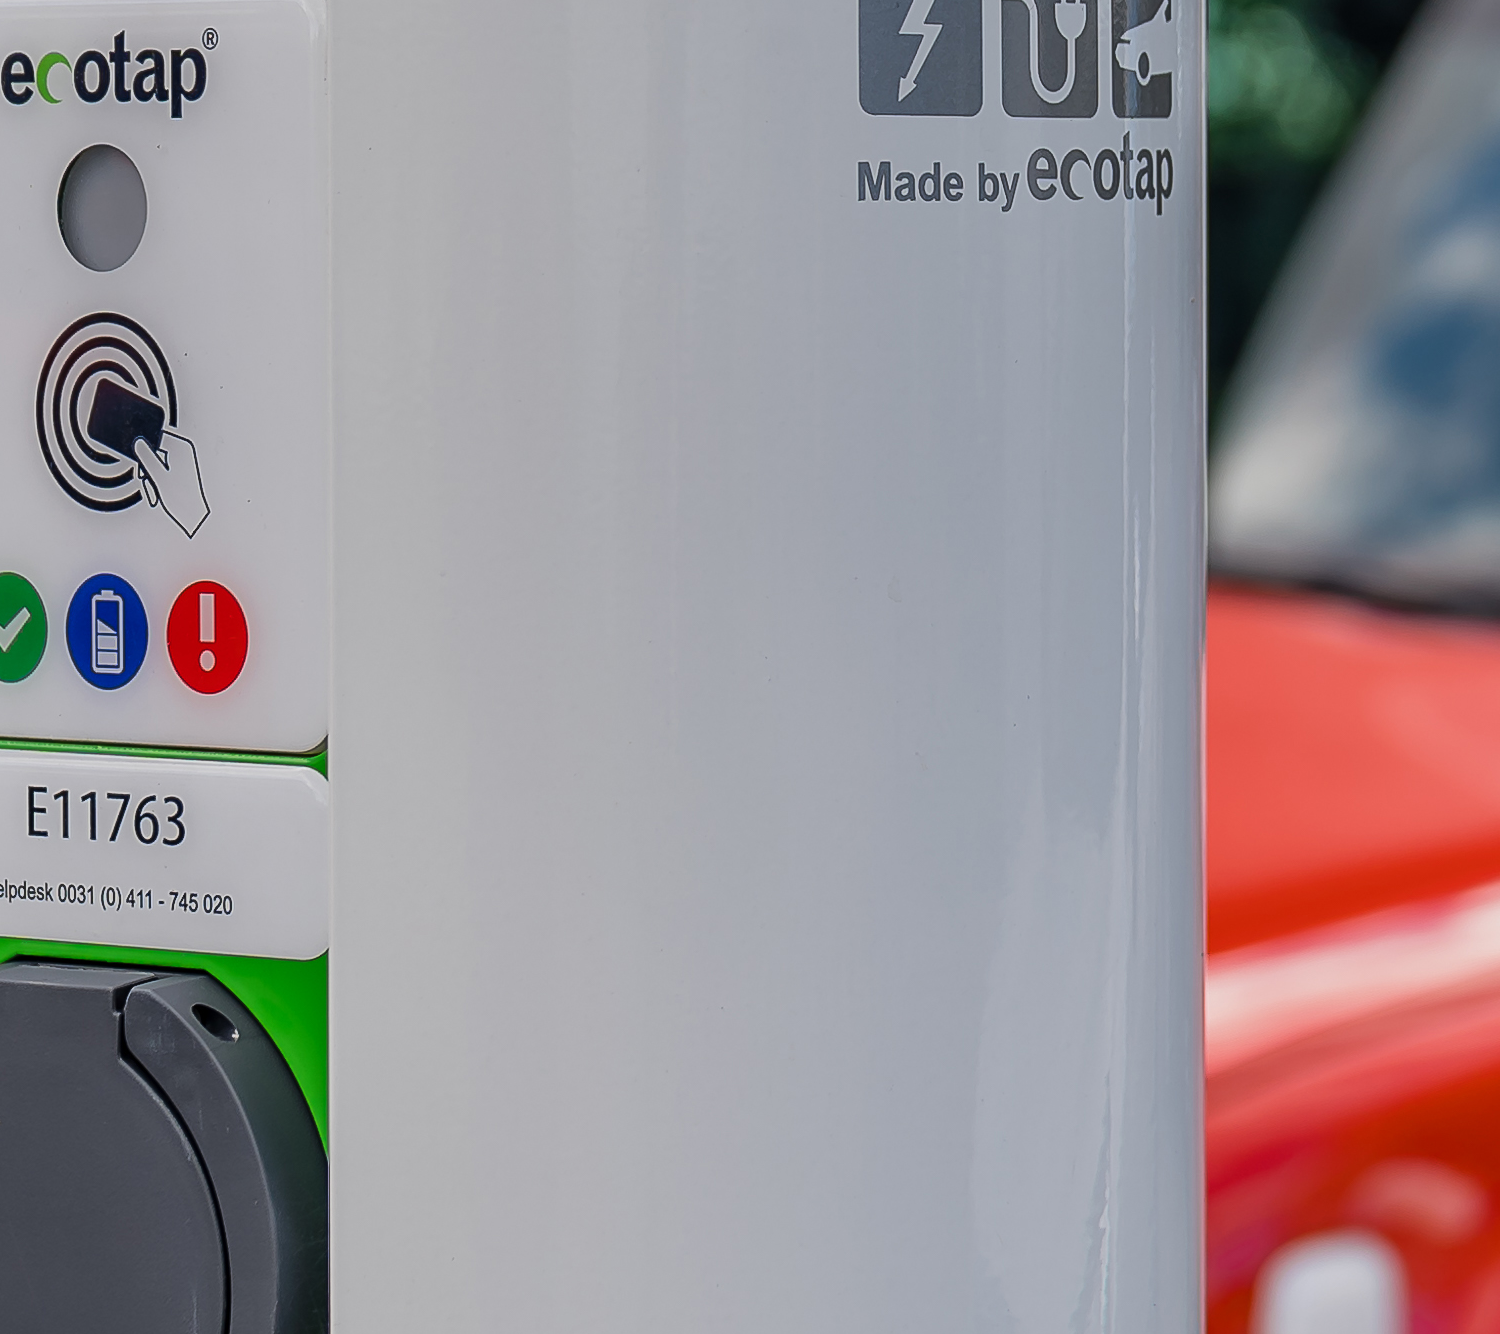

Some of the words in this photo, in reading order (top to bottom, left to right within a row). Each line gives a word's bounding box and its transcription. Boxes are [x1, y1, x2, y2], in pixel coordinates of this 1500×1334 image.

[857, 161, 964, 202] Made
[978, 162, 1020, 213] by
[1026, 130, 1174, 216] ecotap
[27, 786, 186, 846] E11763
[57, 883, 94, 905] 0031
[100, 886, 122, 911] (0)
[125, 888, 152, 909] 411
[168, 891, 199, 913] 745
[203, 893, 233, 915] 020
